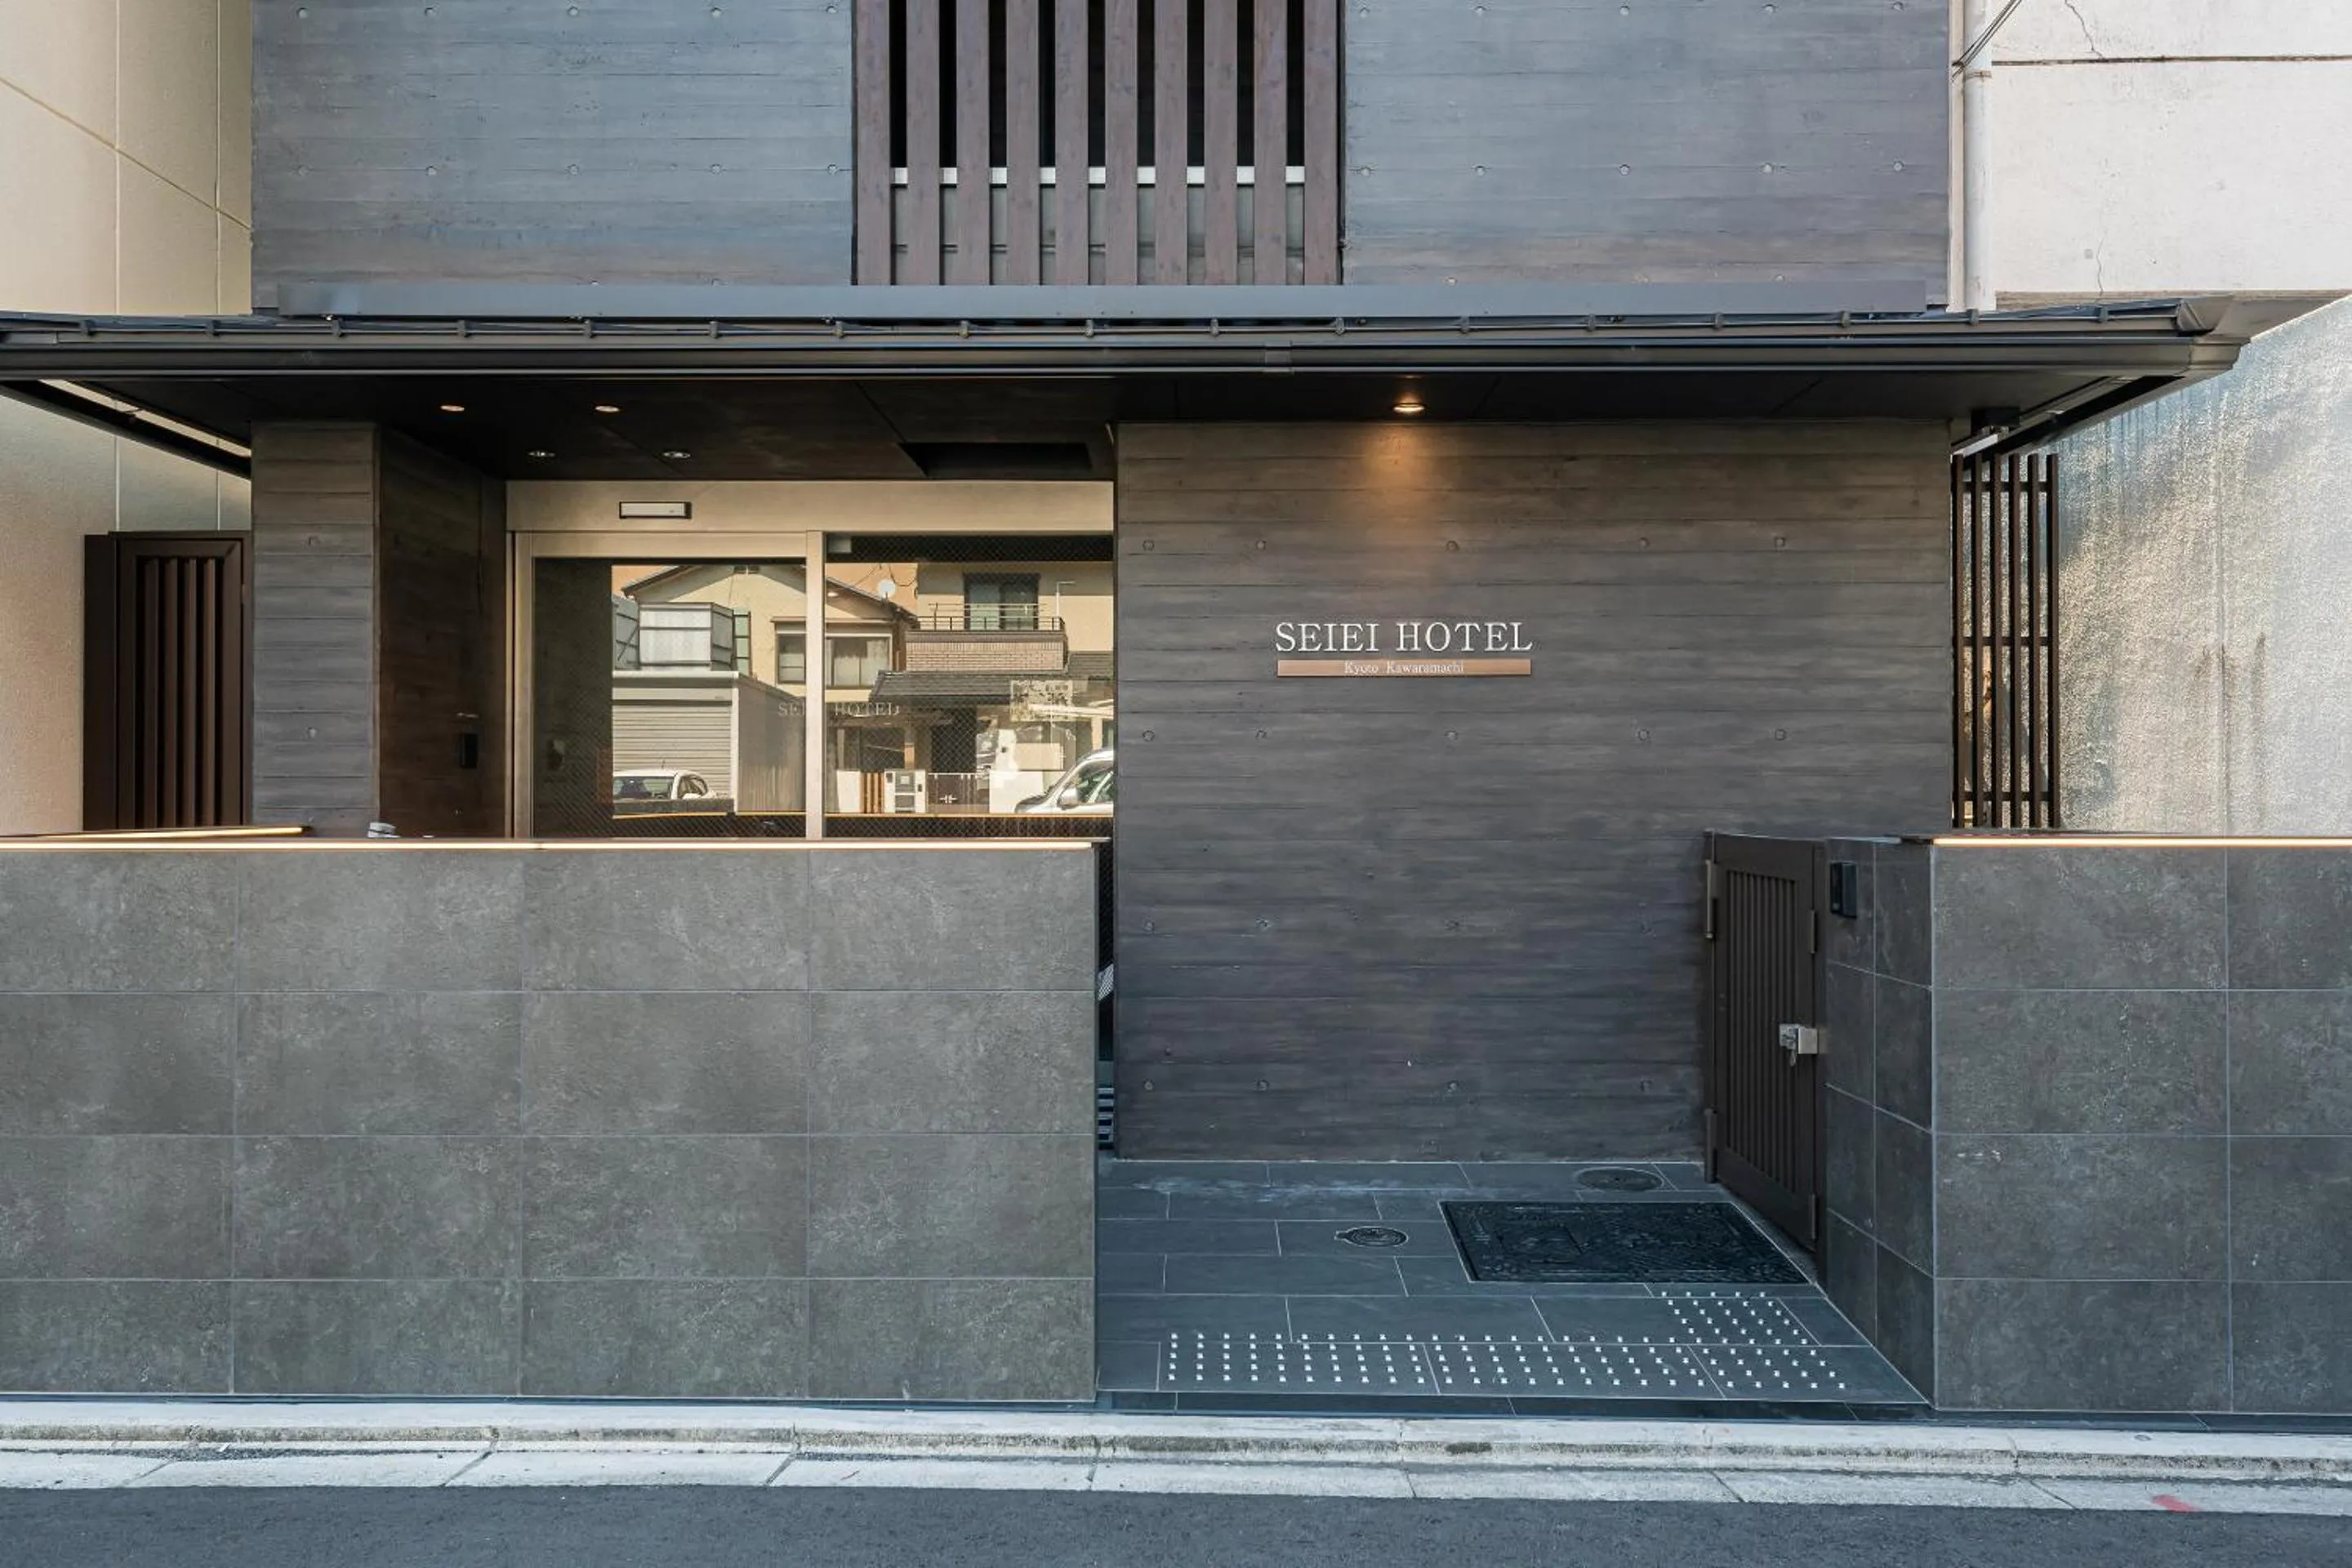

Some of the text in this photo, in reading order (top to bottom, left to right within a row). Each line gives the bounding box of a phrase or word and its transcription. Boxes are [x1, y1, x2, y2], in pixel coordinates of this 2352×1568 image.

[1275, 621, 1533, 652] SEIEI HOTEL
[1344, 660, 1463, 675] Kyoto Kawaramachi
